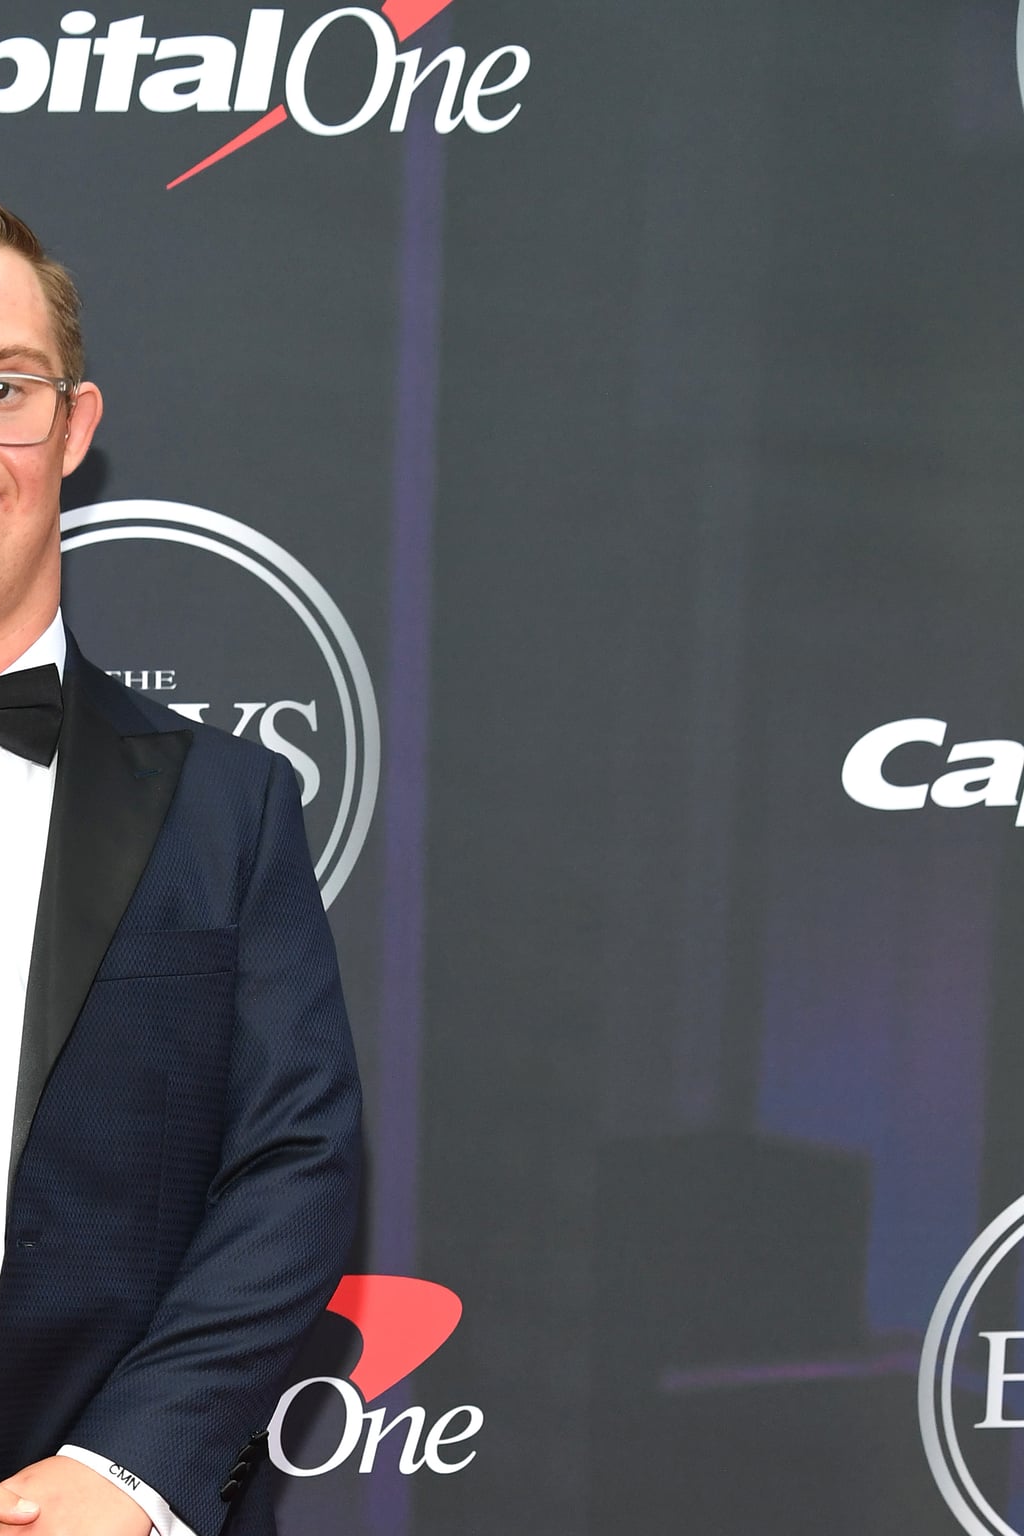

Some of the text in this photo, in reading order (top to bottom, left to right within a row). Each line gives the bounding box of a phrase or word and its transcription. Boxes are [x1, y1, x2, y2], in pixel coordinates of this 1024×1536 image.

[841, 717, 1024, 827] Ca
[109, 1463, 141, 1491] CMN
[266, 1376, 484, 1477] One
